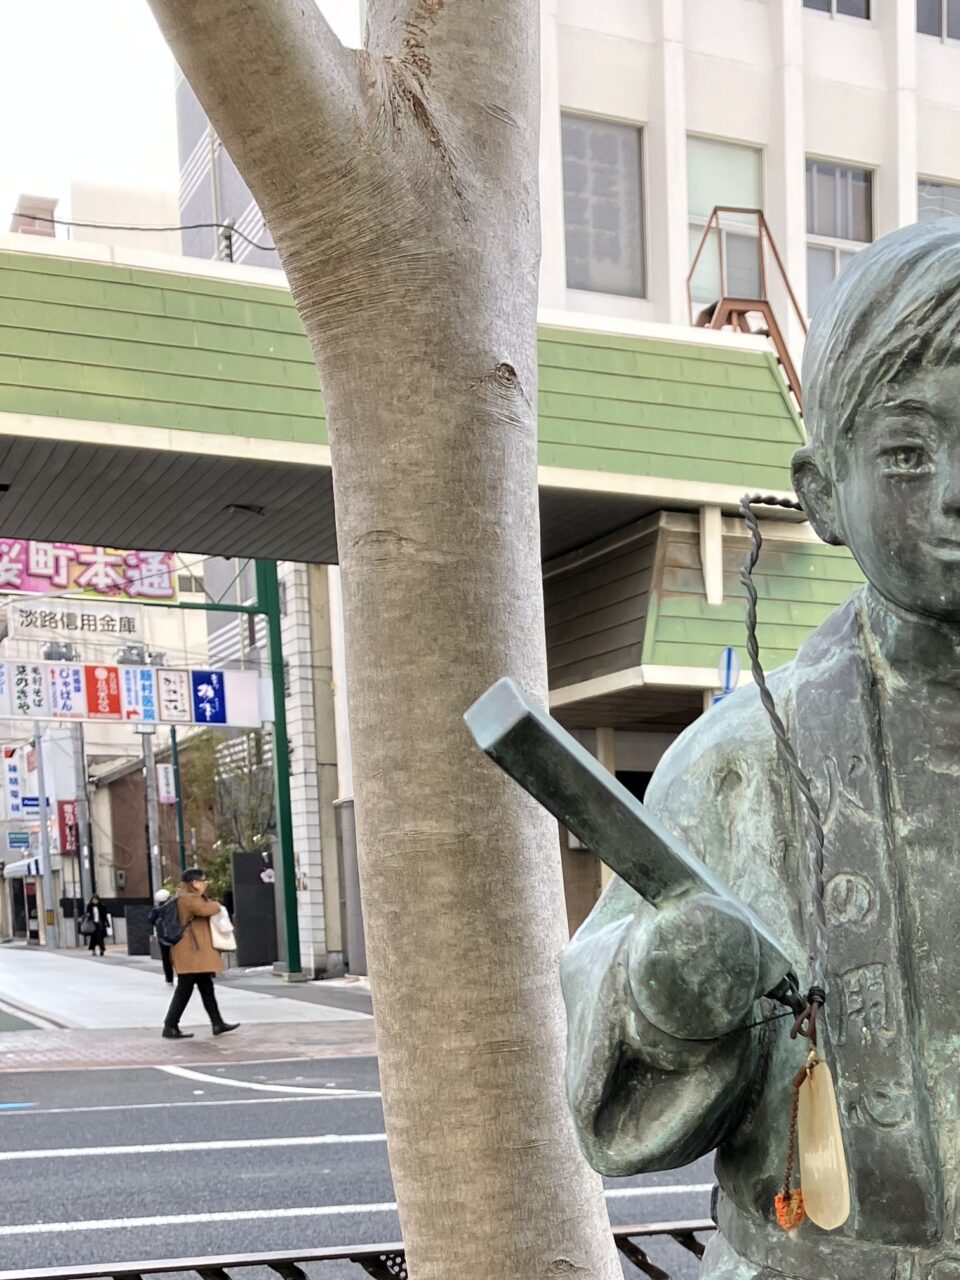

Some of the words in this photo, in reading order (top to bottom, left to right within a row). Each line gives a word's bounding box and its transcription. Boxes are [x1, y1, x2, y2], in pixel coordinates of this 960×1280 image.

[19, 608, 137, 635] 淡路信用金庫
